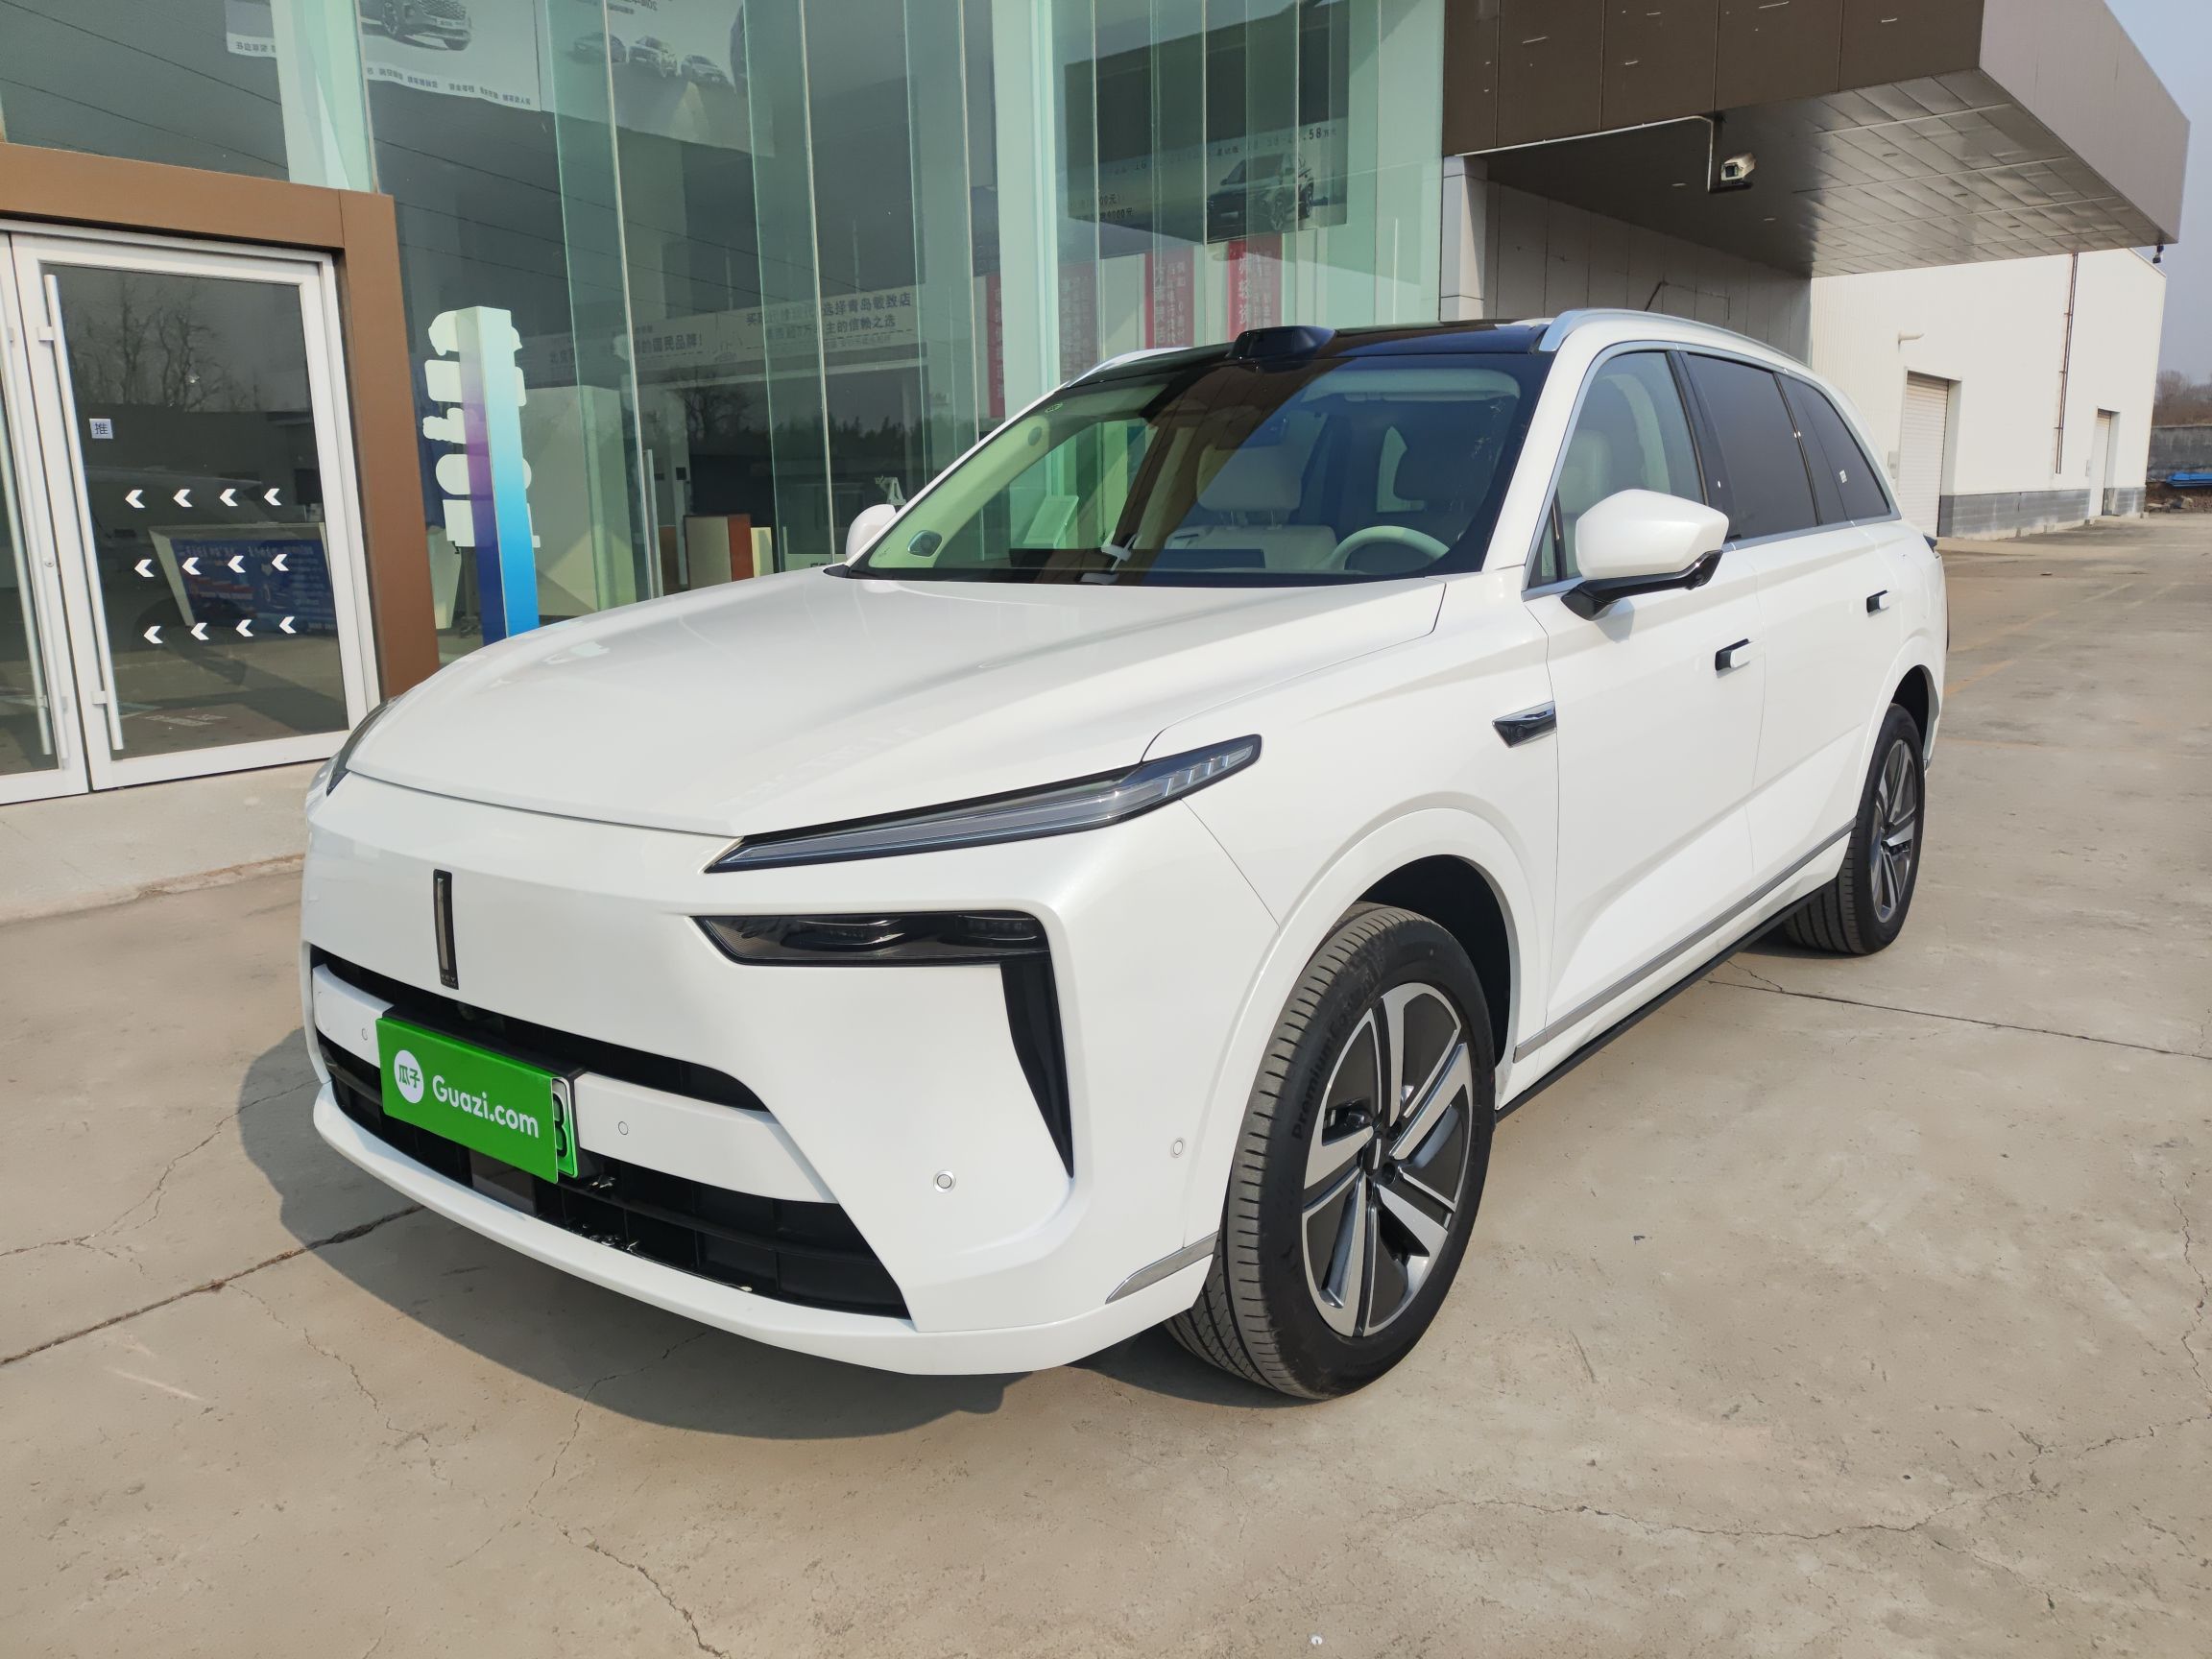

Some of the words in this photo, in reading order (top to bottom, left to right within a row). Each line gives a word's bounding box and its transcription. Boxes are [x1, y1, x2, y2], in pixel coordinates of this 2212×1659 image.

[94, 422, 108, 435] 推
[398, 1064, 420, 1089] 瓜子
[432, 1075, 540, 1138] Guazi.com
